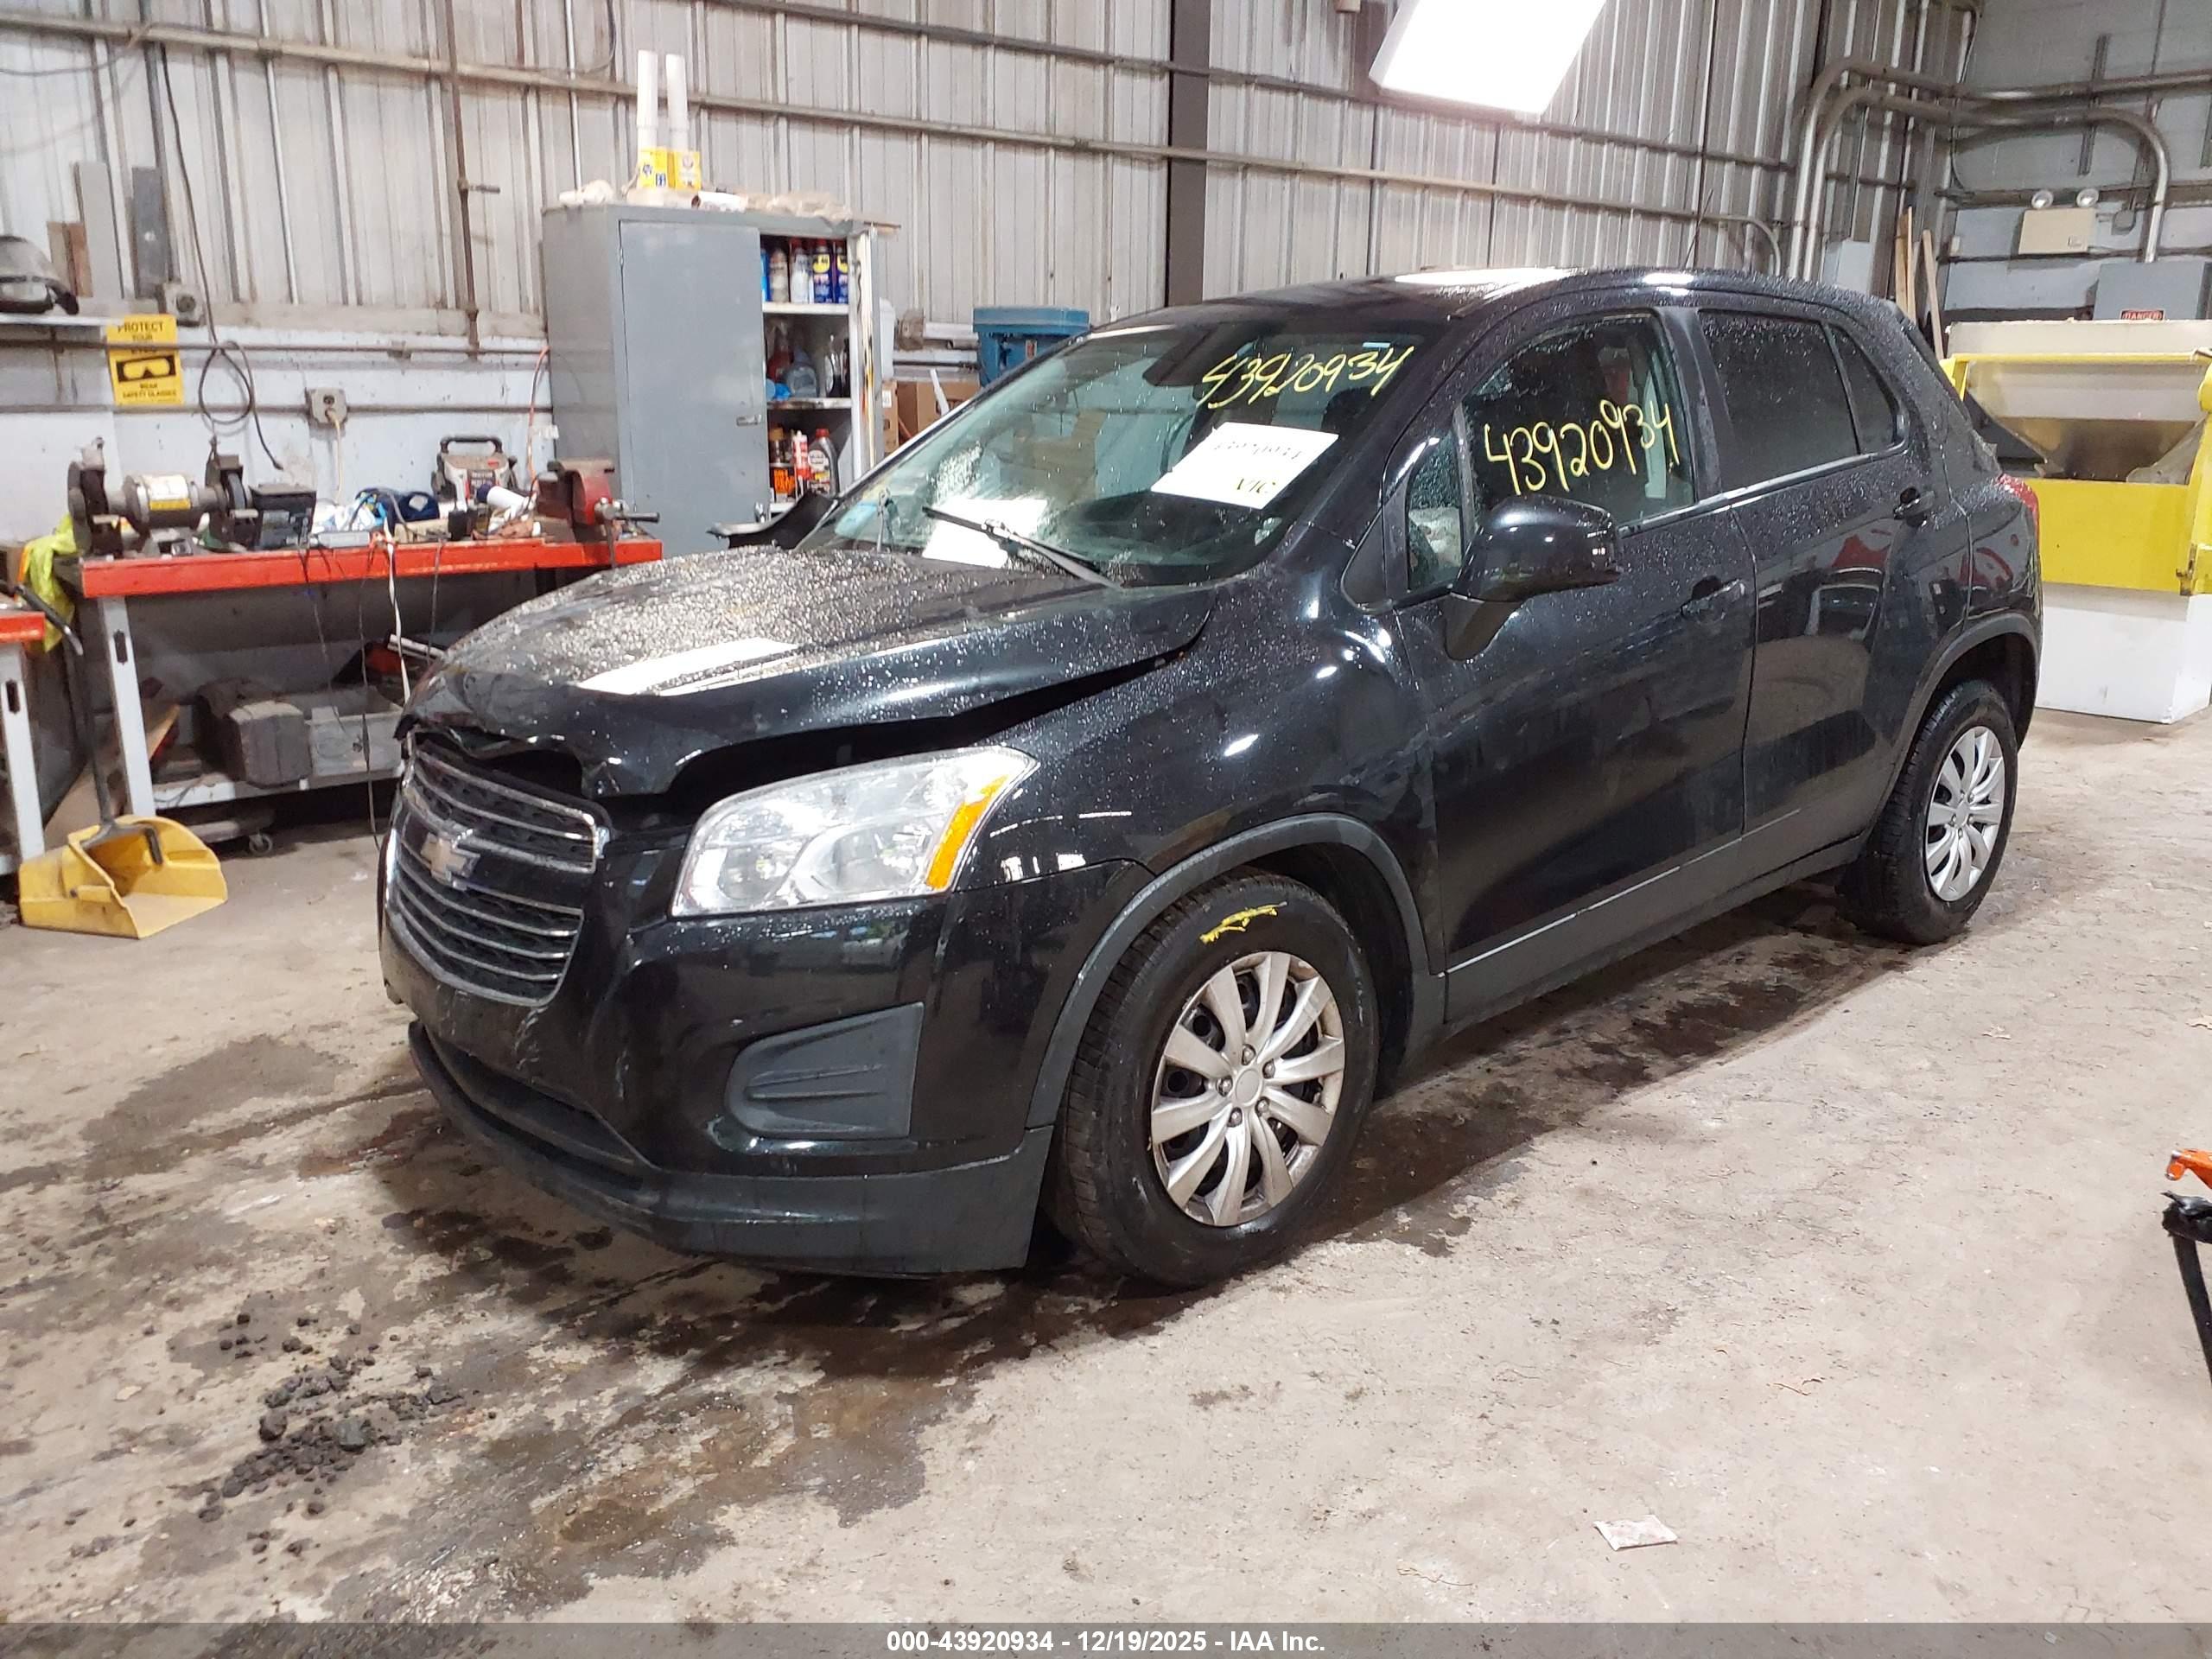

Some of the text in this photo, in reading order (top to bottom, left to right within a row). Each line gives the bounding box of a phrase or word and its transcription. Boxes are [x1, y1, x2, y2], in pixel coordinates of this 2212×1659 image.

[118, 321, 163, 332] PROTECT
[1196, 346, 1415, 409] 43920934
[1484, 399, 1681, 496] 43920934
